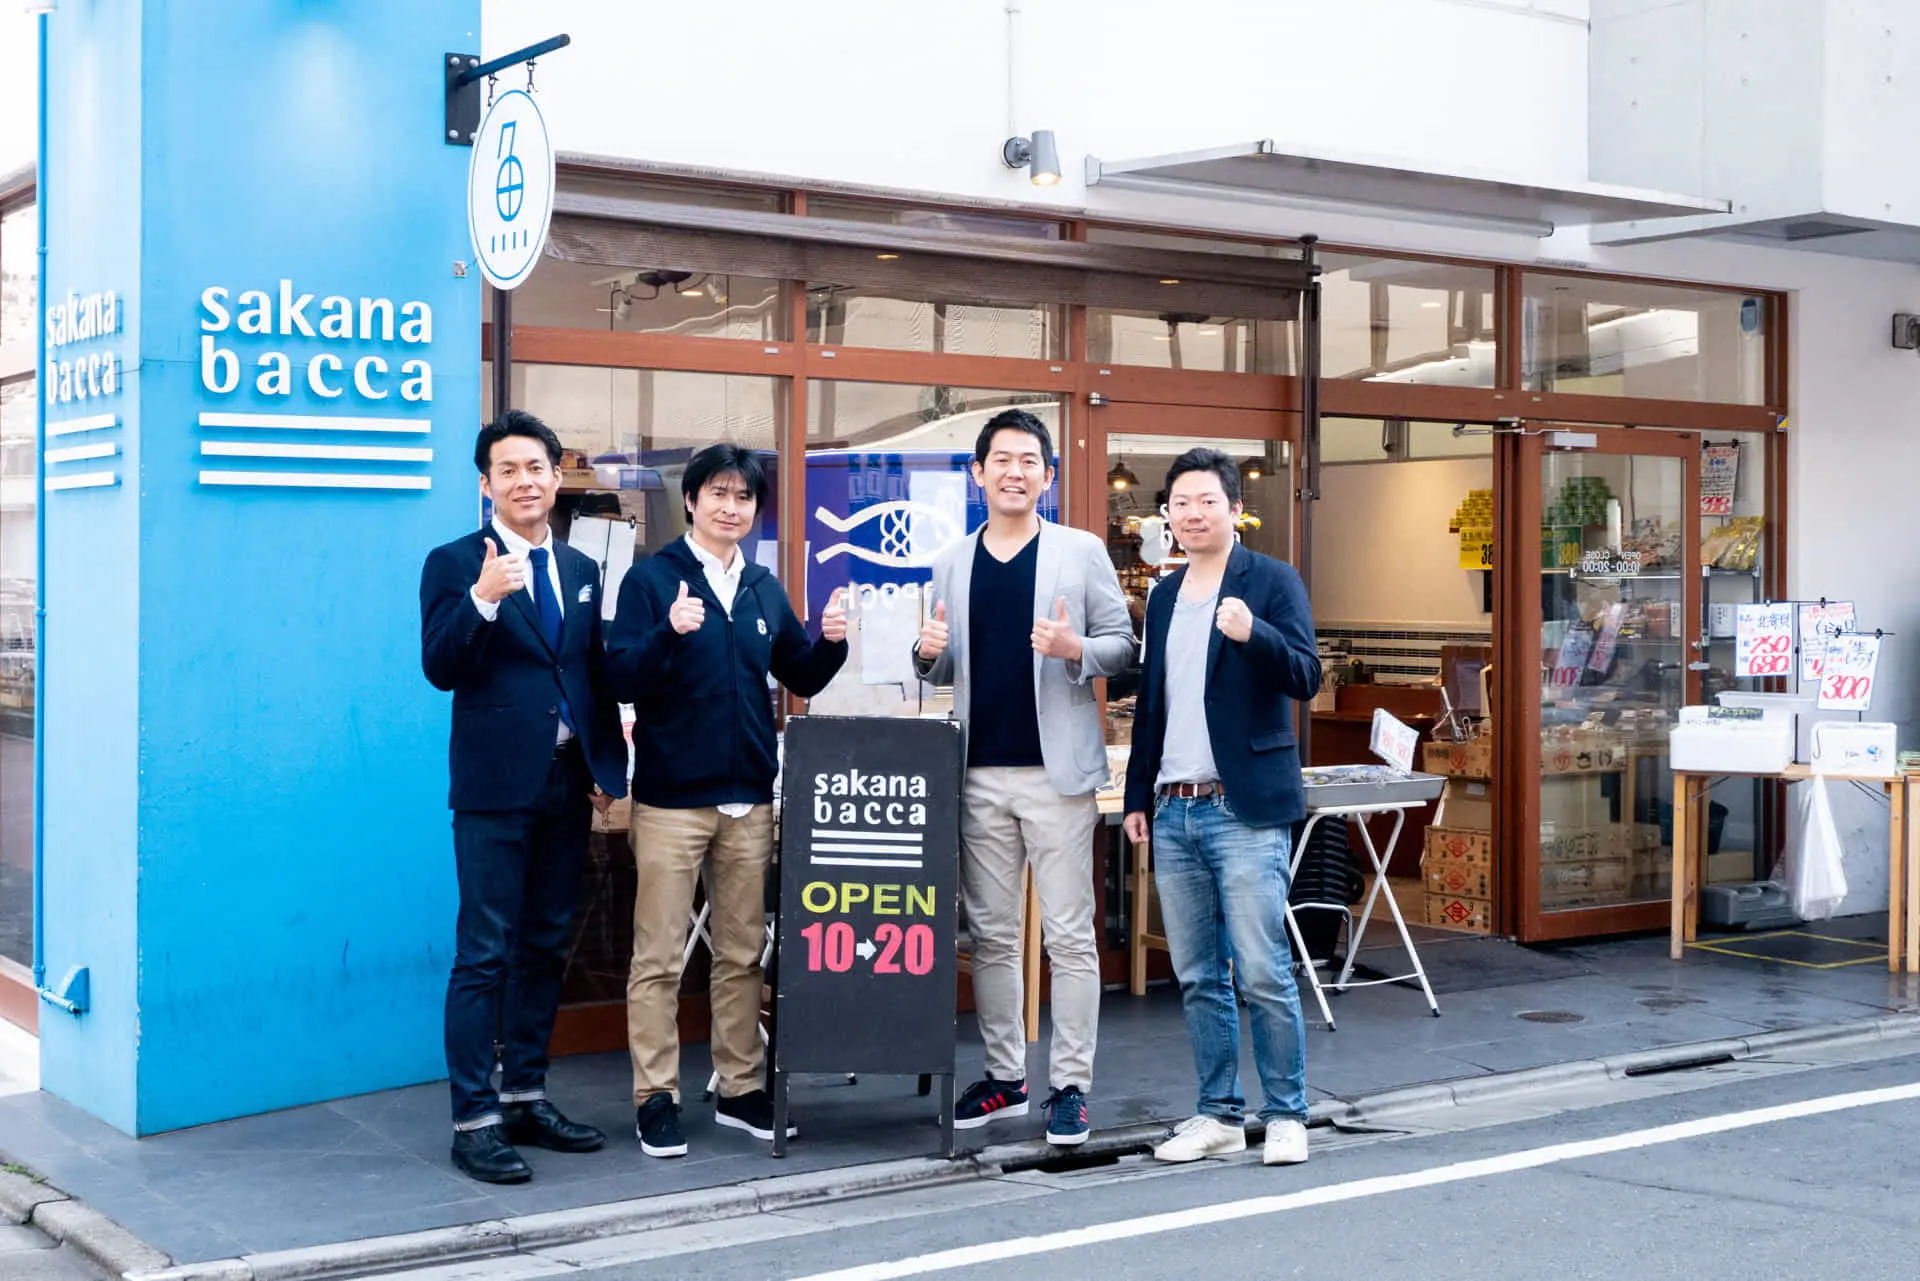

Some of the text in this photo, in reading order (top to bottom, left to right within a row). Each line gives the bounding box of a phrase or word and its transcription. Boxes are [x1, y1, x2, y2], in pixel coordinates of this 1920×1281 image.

[47, 289, 115, 349] sakana
[201, 279, 432, 343] sakana
[47, 351, 115, 405] bacca
[201, 335, 433, 401] bacca
[1749, 655, 1790, 675] 680
[1822, 673, 1870, 700] 300
[814, 769, 926, 798] sakana
[814, 796, 926, 825] bacca
[801, 881, 936, 916] OPEN
[801, 922, 935, 976] 10 20
